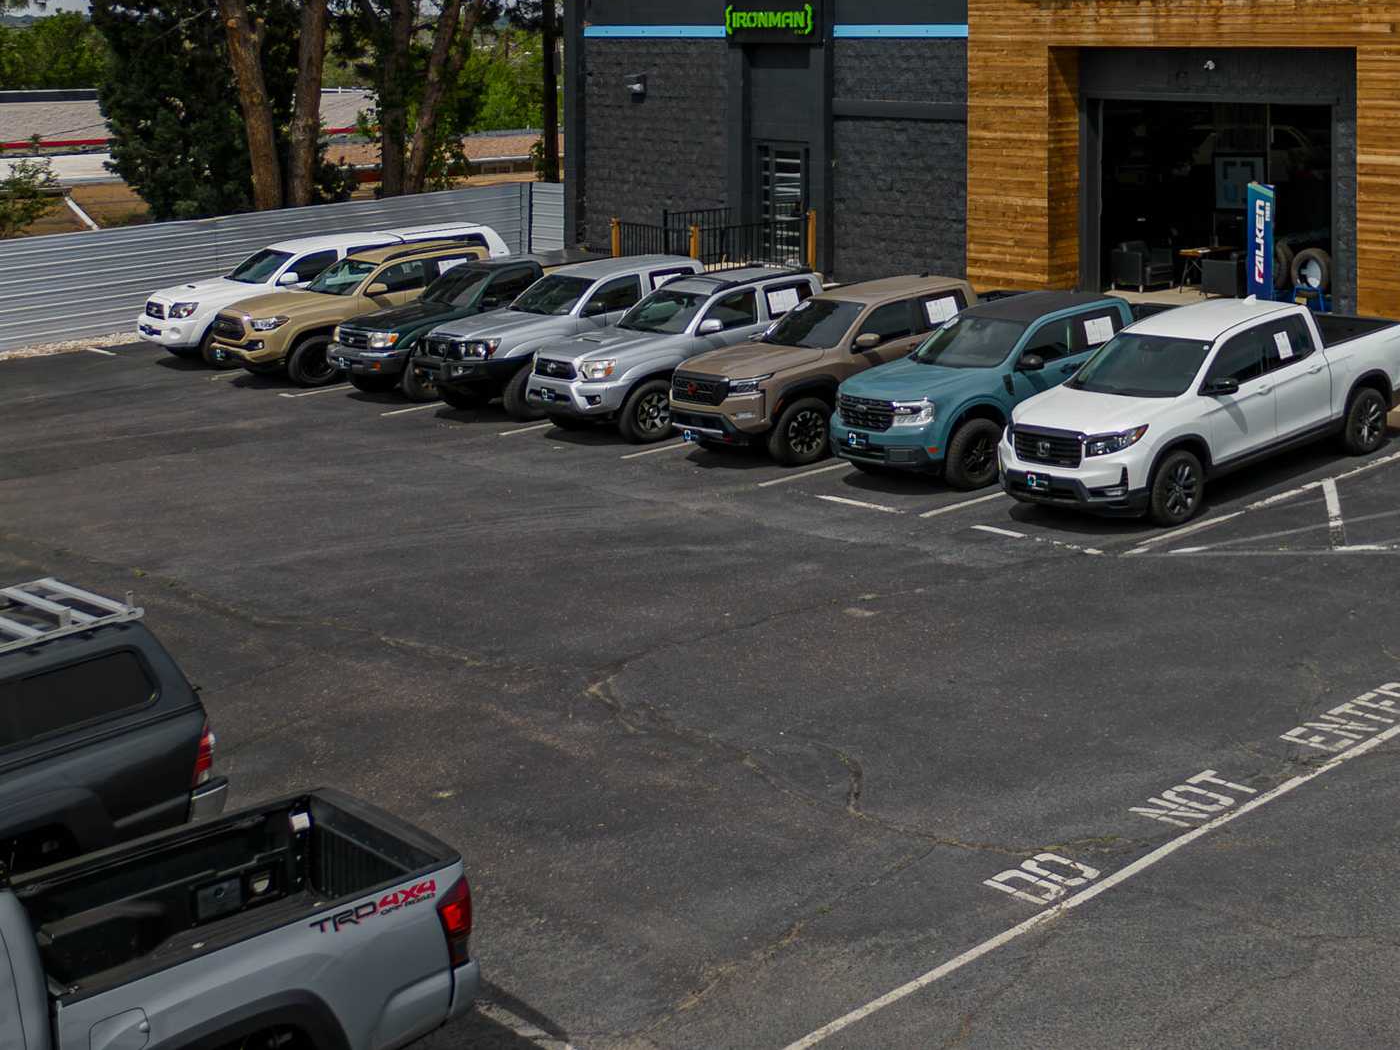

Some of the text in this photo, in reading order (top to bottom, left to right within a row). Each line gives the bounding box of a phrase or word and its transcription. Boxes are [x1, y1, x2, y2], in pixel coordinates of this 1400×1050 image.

[982, 852, 1100, 905] DO
[1128, 769, 1257, 828] NOT
[309, 901, 378, 933] TRD
